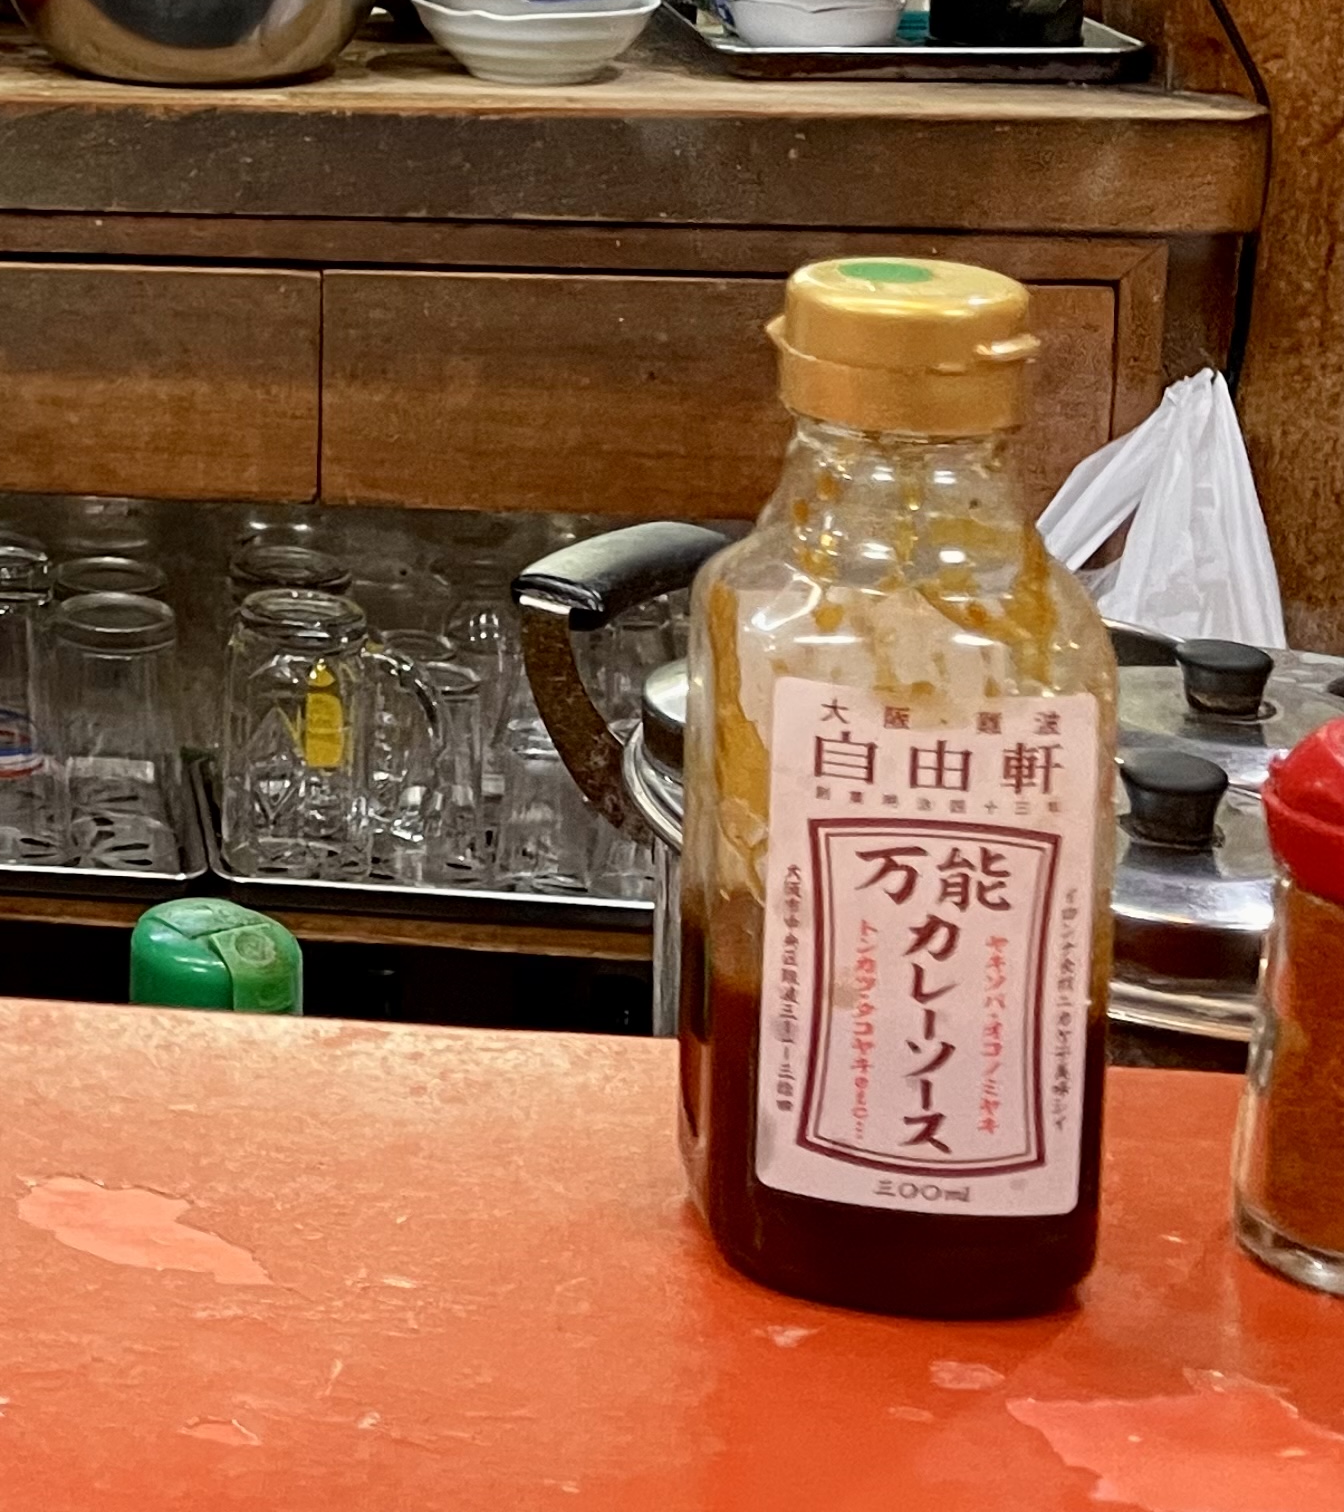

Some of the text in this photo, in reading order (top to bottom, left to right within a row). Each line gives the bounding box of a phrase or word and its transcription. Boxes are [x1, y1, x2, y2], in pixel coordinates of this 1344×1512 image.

[814, 731, 1064, 795] 自由軒
[854, 845, 1011, 913] 万能
[899, 913, 961, 1154] カレーソース
